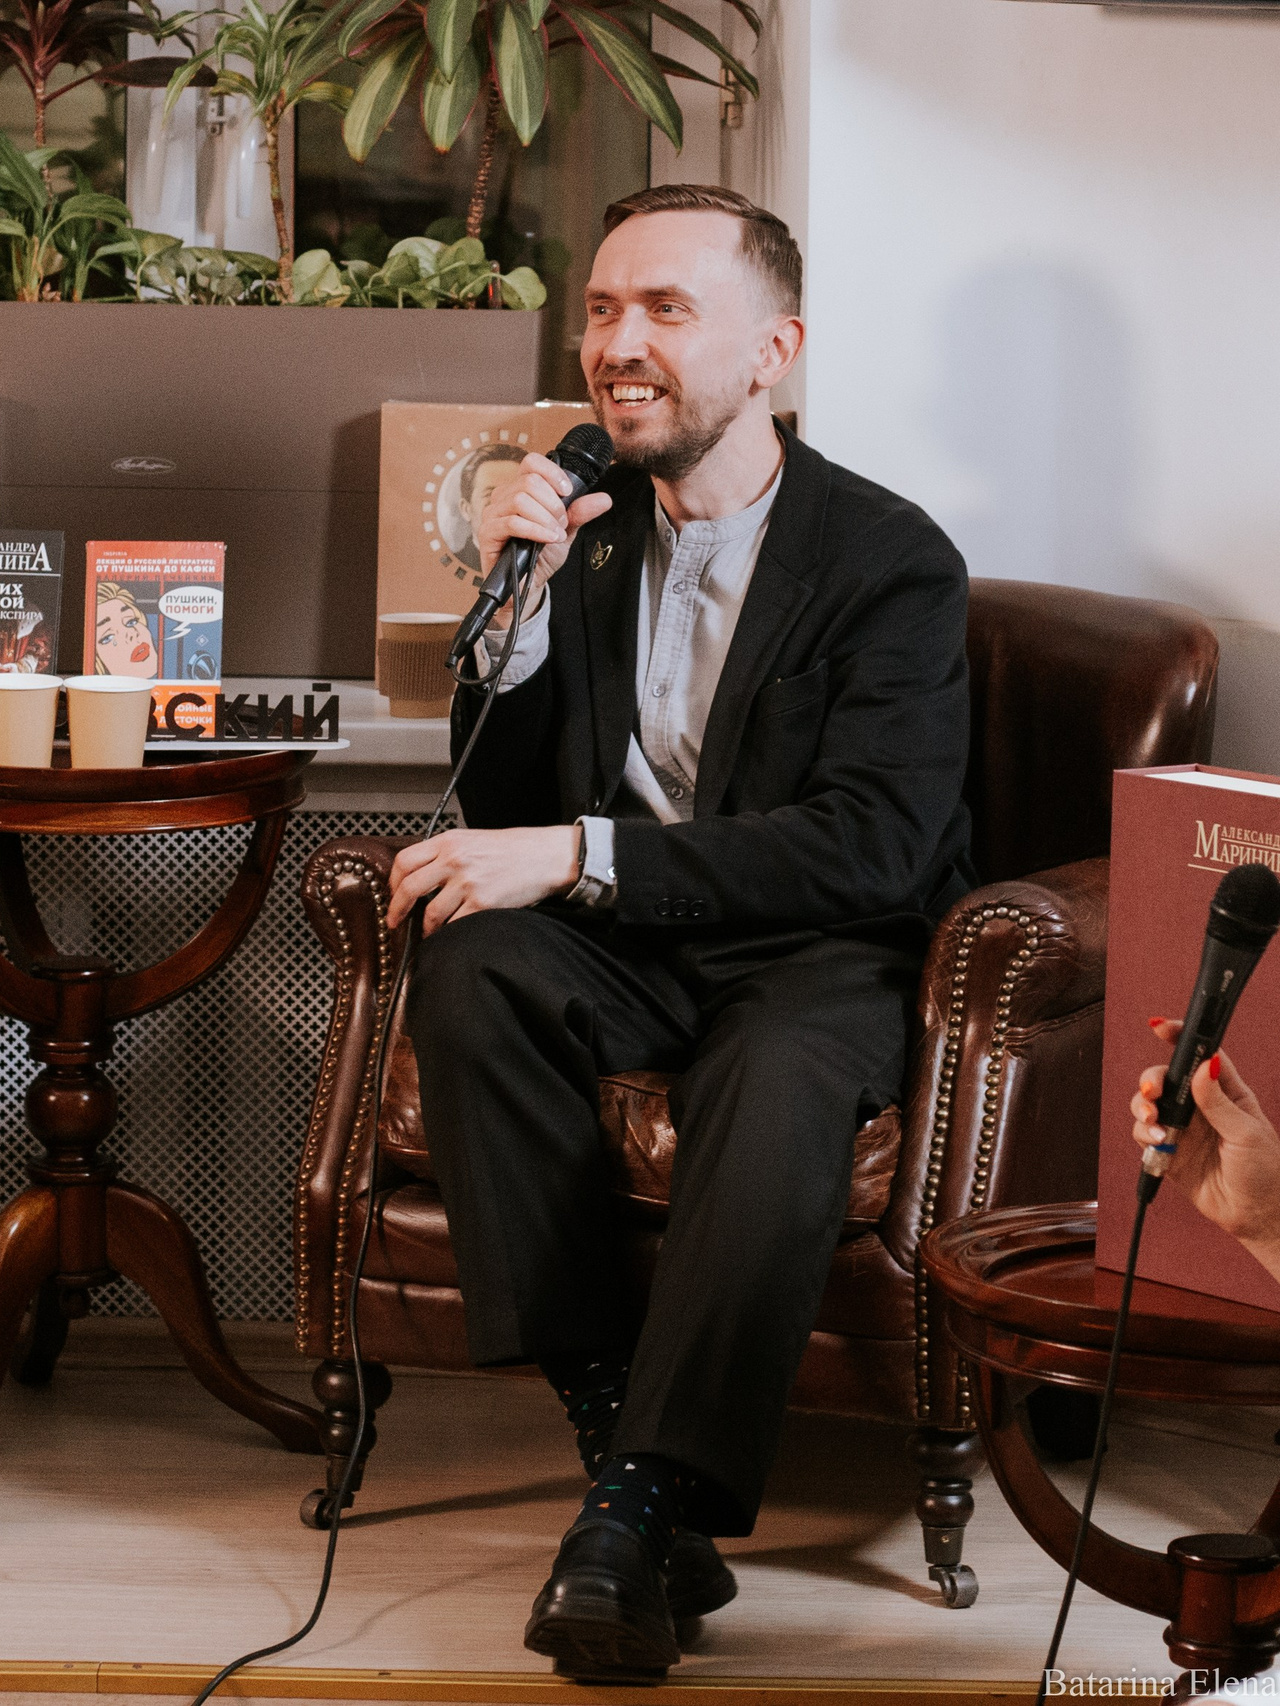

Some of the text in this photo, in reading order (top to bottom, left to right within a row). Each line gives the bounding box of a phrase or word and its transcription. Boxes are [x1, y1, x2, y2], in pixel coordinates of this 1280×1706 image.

[134, 557, 167, 565] РУССКОЙ
[96, 565, 215, 573] ОТ ПУШКИНА ДО КАФКИ
[166, 595, 217, 605] ПУШКИН,
[166, 605, 214, 614] ПОМОГИ
[173, 704, 213, 713] ОЙНЫЕ
[159, 716, 213, 724] ЛСТОЧКИ
[1221, 826, 1280, 848] АЛЕКСАНД
[1193, 820, 1280, 873] МАРИНИ
